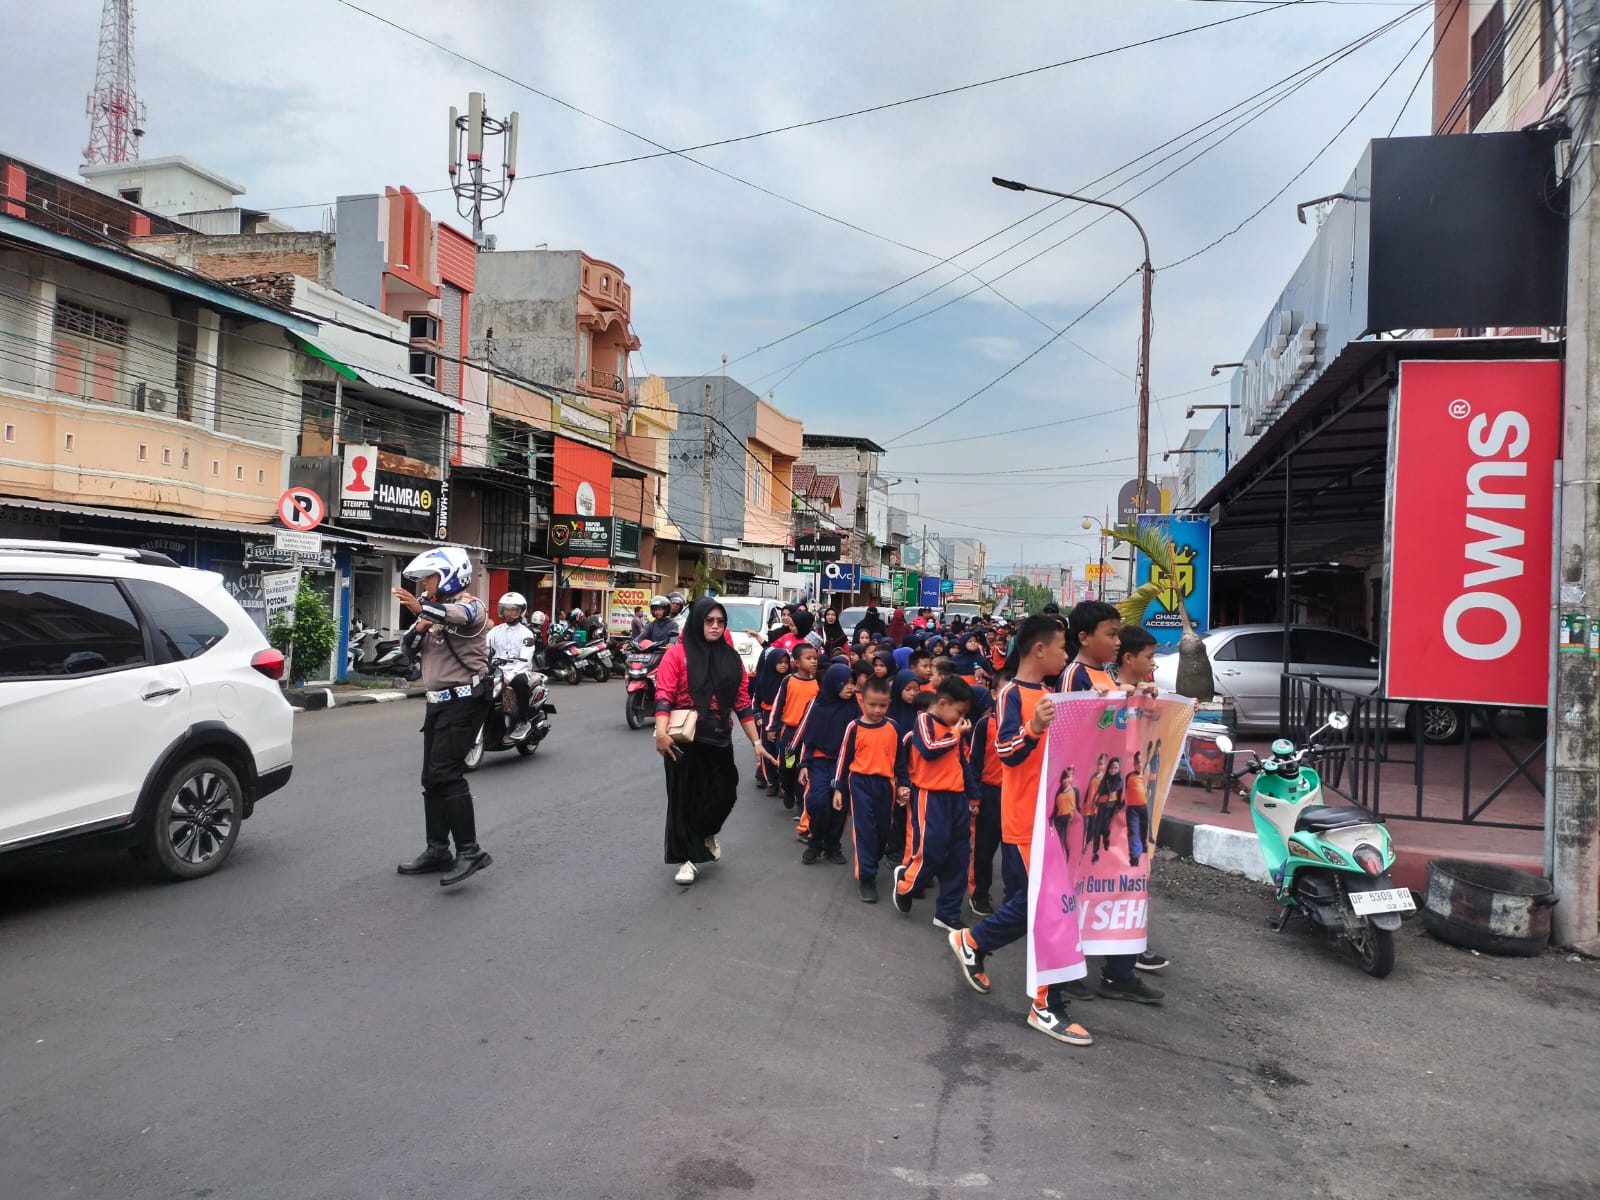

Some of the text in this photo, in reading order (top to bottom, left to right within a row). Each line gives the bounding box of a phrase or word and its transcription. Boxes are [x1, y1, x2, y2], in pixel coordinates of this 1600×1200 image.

[292, 495, 313, 522] P
[343, 500, 370, 508] STEMPEL
[800, 544, 836, 553] SAMSUNG
[617, 591, 645, 599] COTO
[1087, 875, 1114, 893] Guru
[1350, 894, 1363, 904] DP
[1369, 891, 1393, 902] 5309
